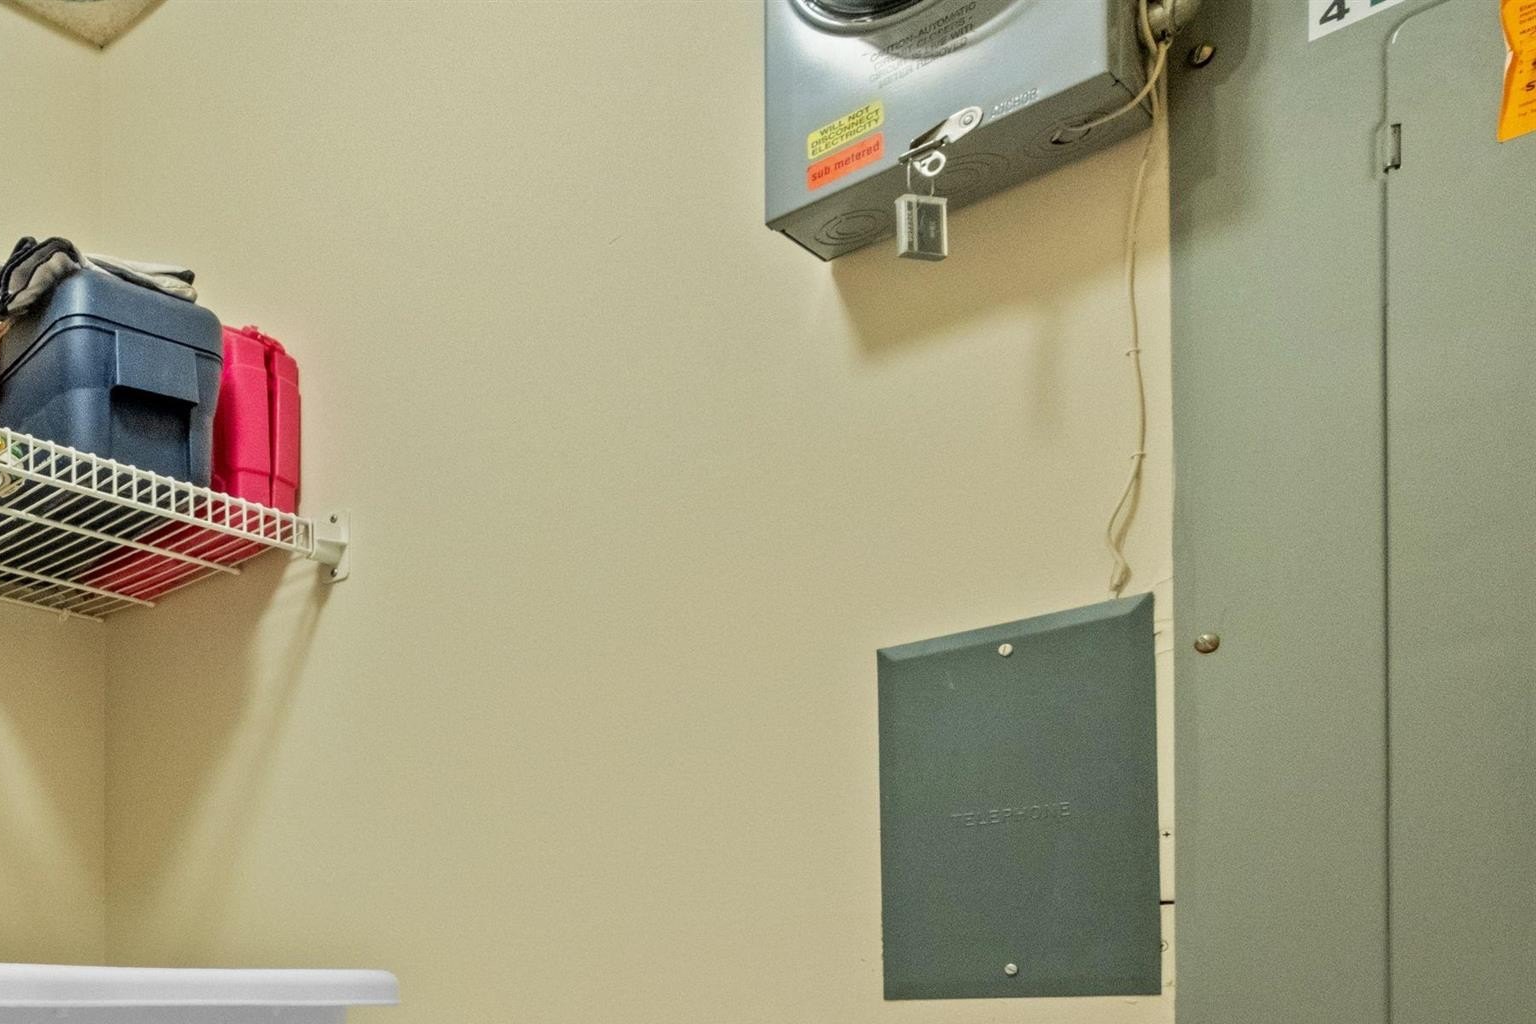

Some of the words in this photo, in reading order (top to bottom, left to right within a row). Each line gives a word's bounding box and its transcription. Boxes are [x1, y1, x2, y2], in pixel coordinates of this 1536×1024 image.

[810, 108, 880, 149] DISCONNECT
[811, 116, 880, 157] ELECTRICITY
[819, 115, 845, 136] WILL
[848, 105, 871, 121] NOT
[810, 164, 832, 182] sub
[834, 140, 881, 172] metered
[950, 801, 1070, 828] TELEPHONE
